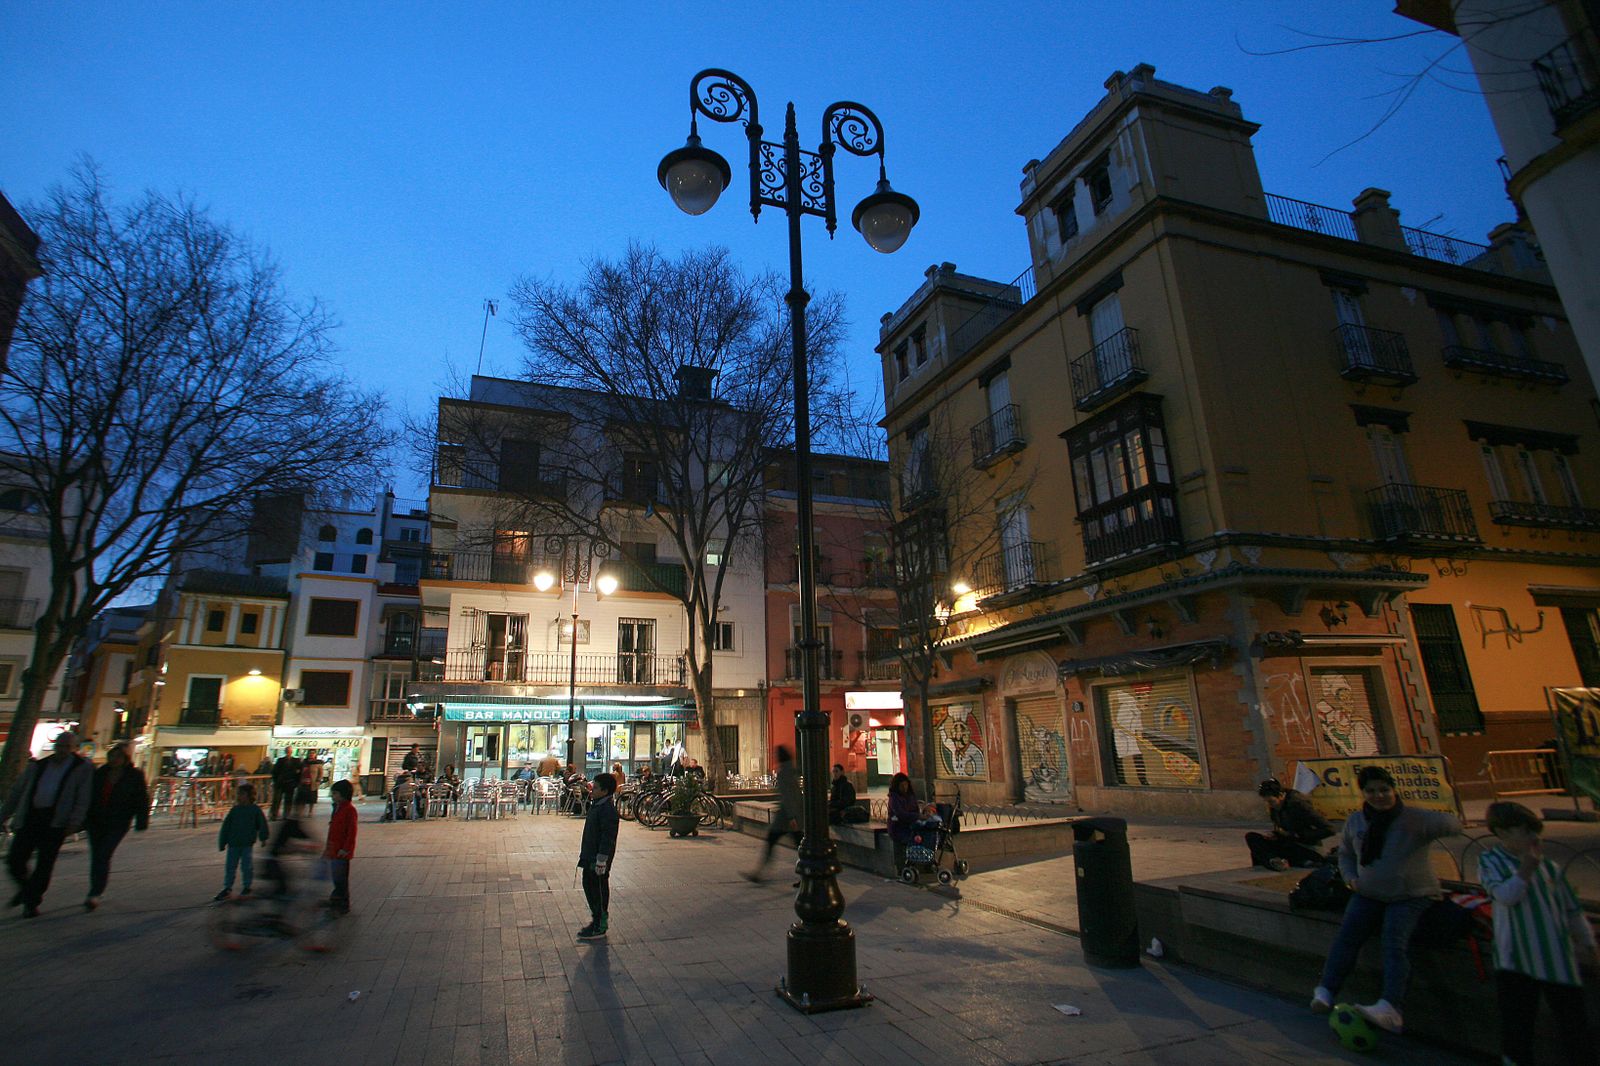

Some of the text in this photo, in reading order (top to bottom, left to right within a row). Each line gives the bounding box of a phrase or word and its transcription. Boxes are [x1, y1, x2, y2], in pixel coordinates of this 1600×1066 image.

[465, 710, 561, 720] BAR MANOLO
[276, 739, 360, 748] FLAMENCO MAYO
[1353, 763, 1438, 776] Ecialistas
